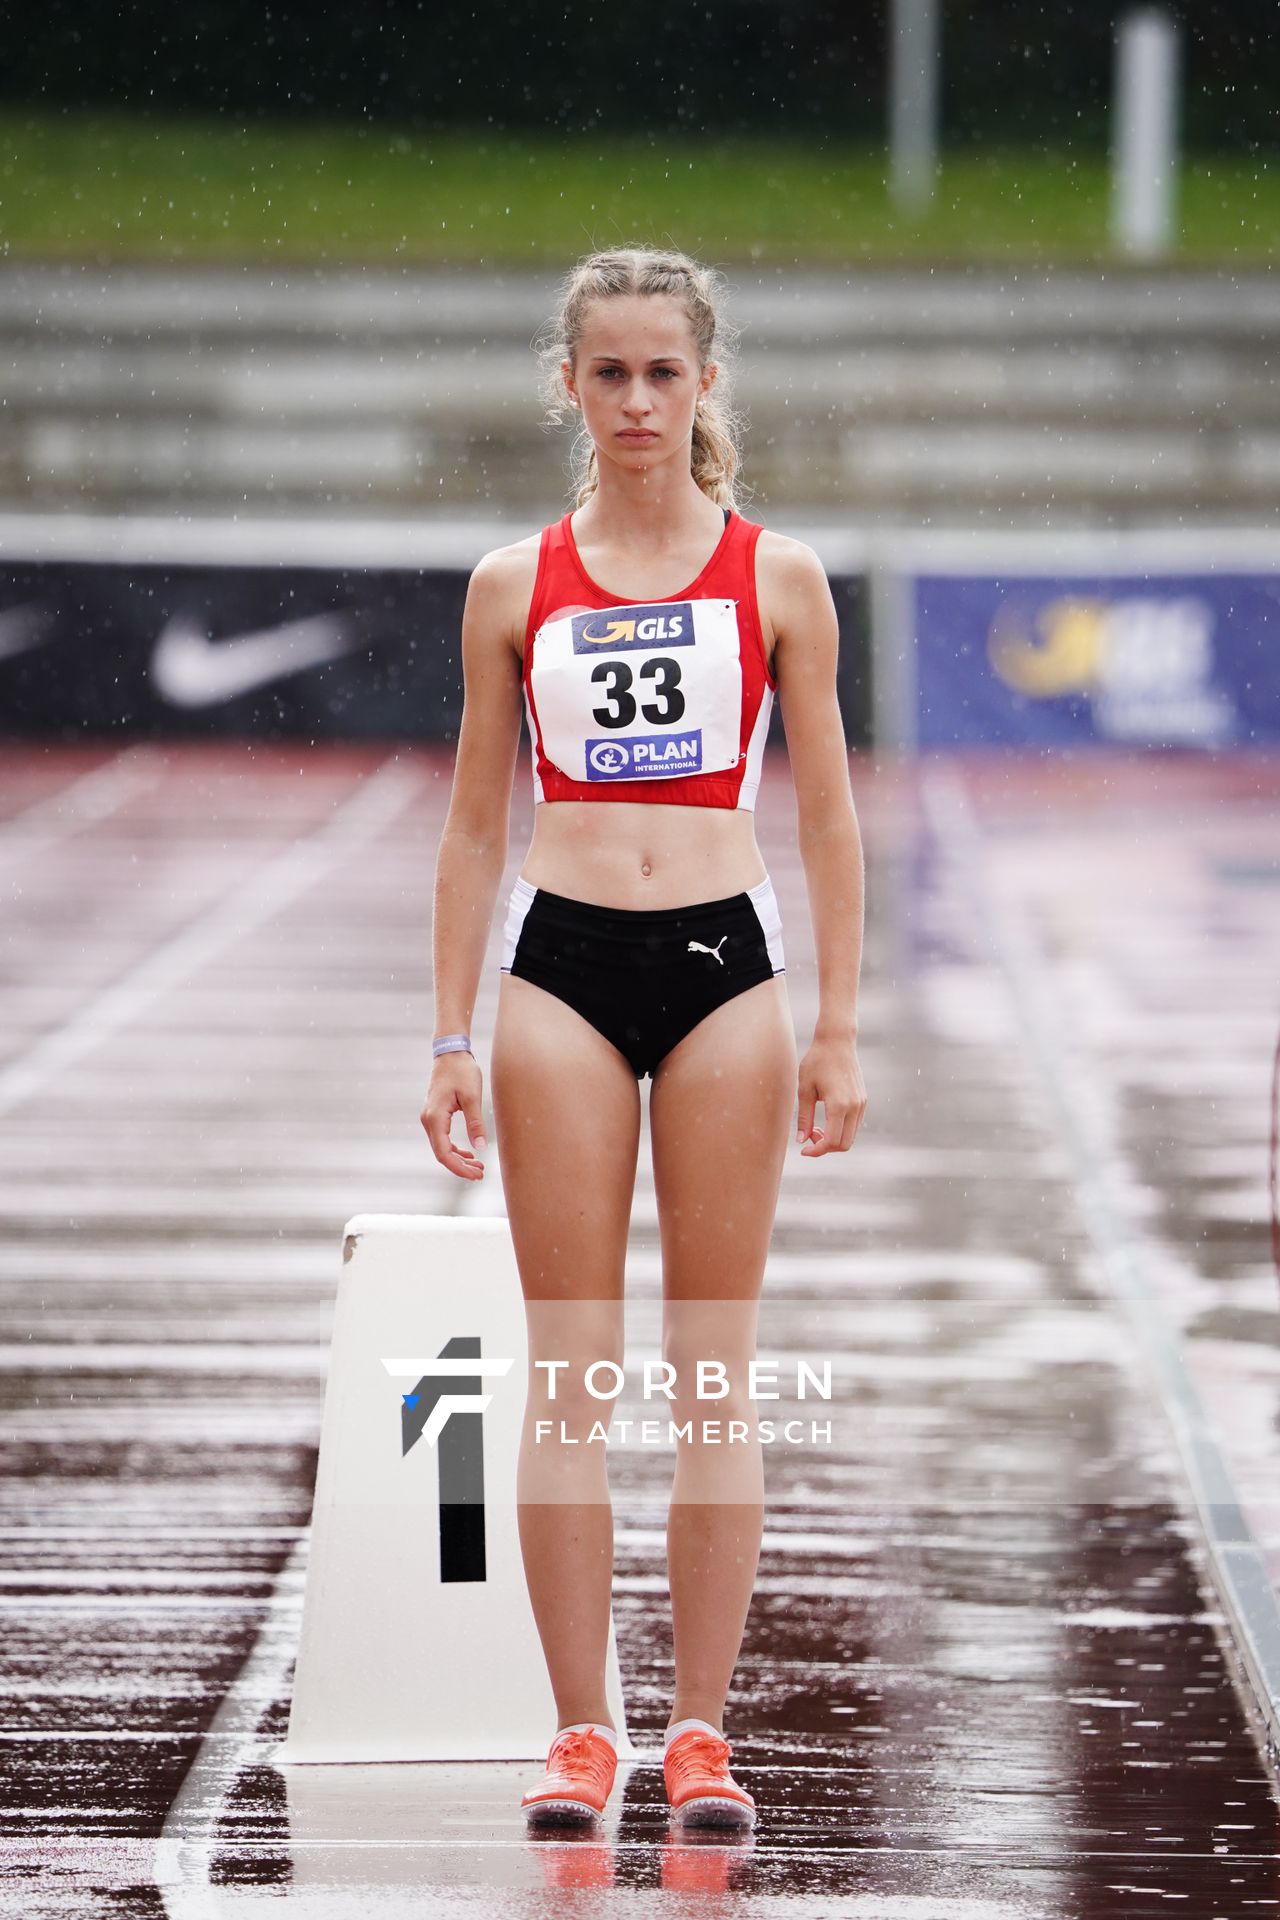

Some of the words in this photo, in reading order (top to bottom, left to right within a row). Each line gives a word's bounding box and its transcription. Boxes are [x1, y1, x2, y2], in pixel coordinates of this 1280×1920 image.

[636, 616, 683, 640] GLS
[591, 657, 685, 729] 33
[634, 740, 697, 762] PLAN
[635, 761, 698, 772] INTERNATIONAL
[402, 1337, 487, 1583] 1
